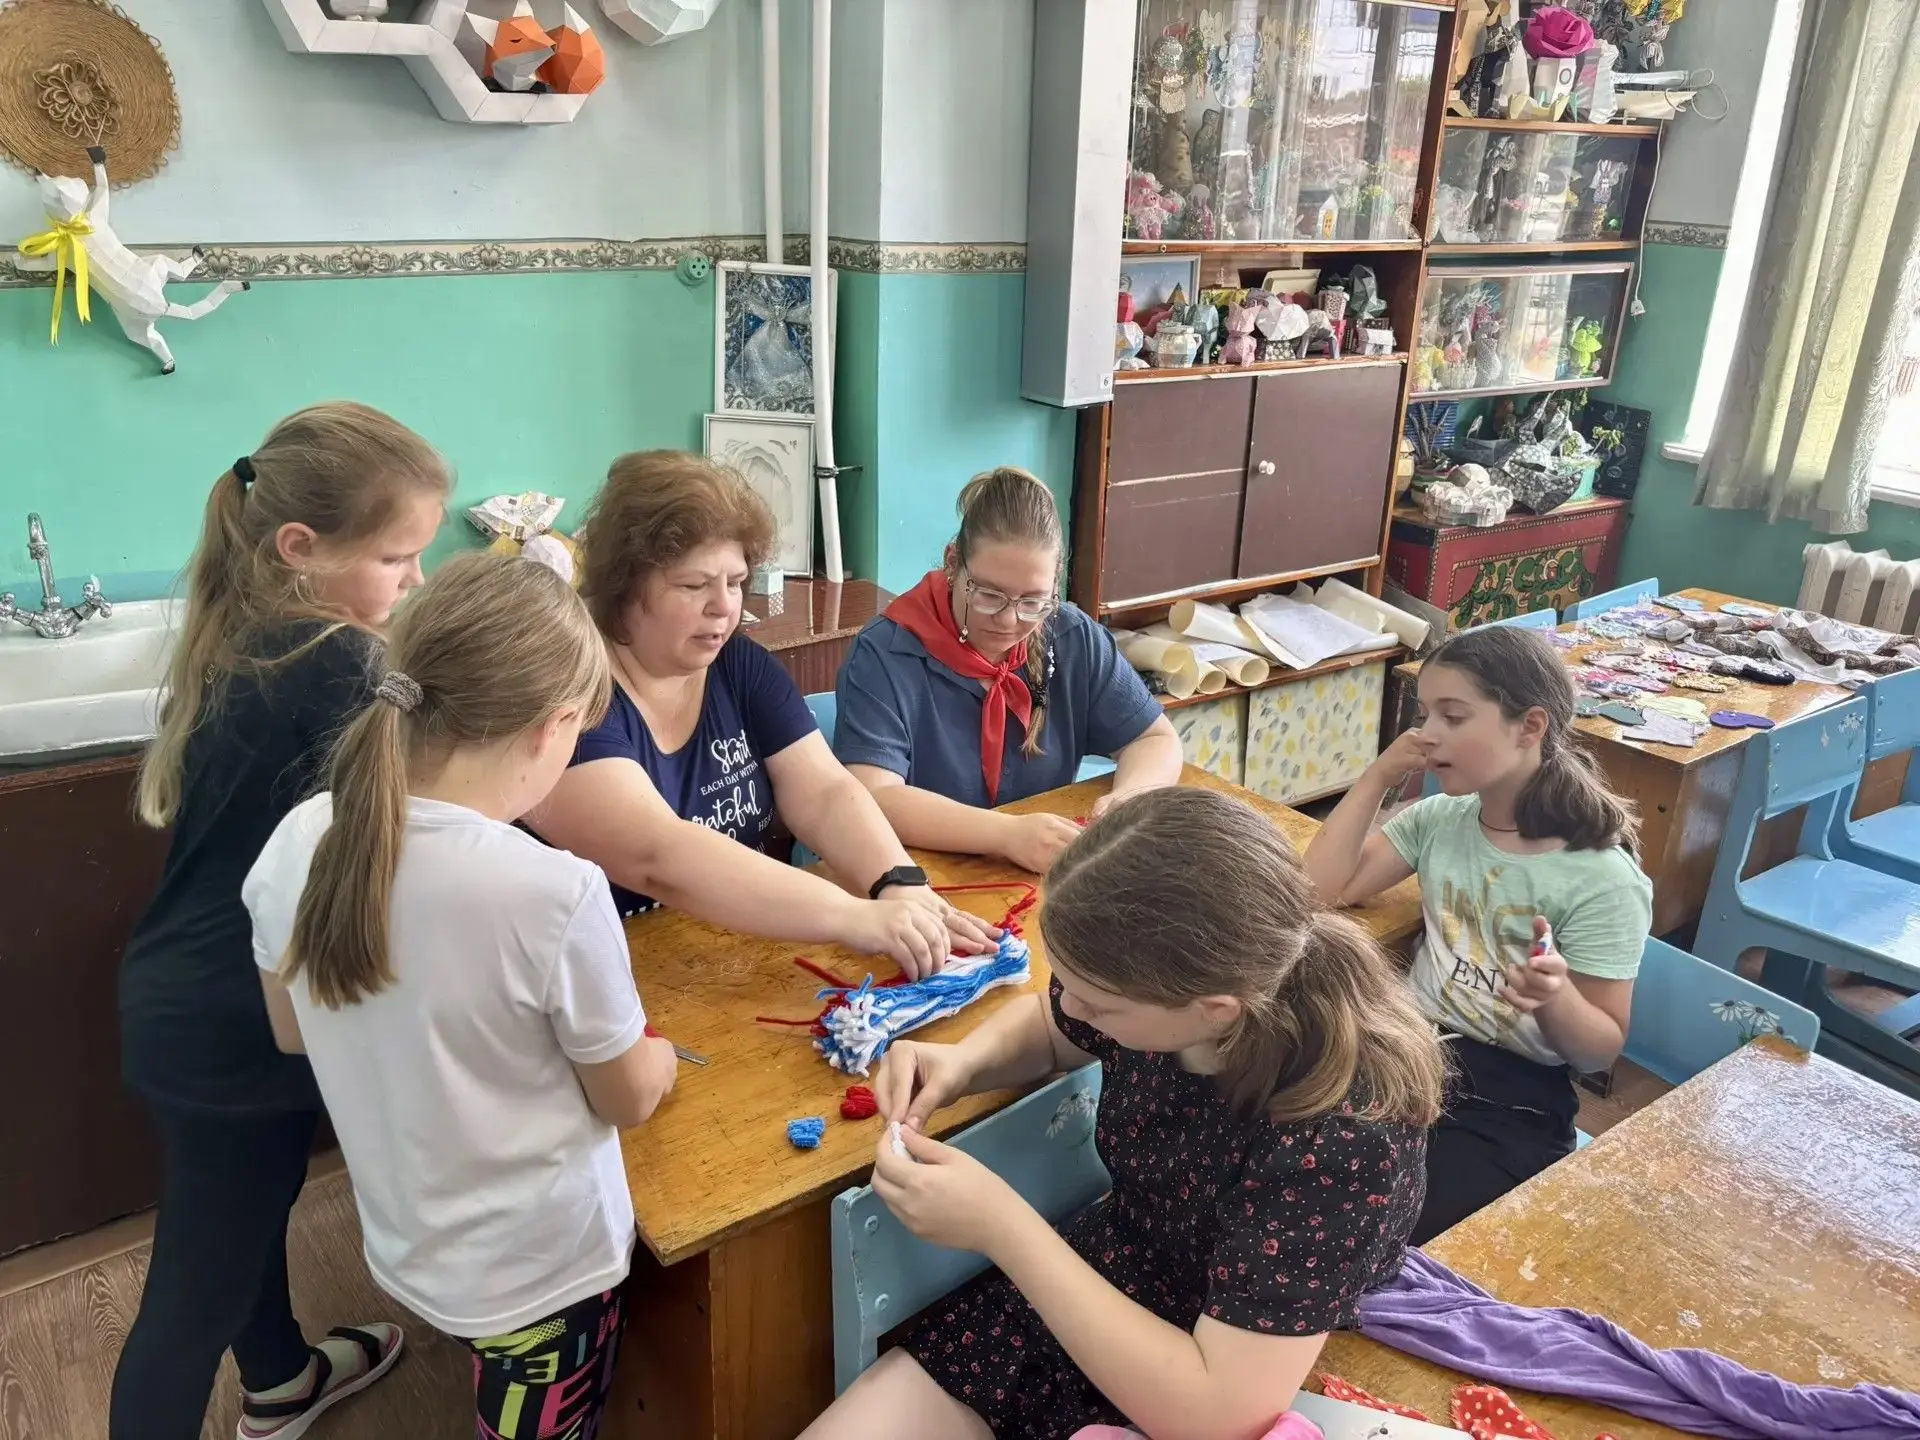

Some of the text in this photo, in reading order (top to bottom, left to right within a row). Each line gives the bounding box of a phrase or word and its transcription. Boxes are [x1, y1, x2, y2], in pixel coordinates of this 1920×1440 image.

[711, 729, 752, 774] Start
[691, 780, 761, 829] rateful
[700, 779, 725, 796] EACH
[725, 771, 740, 785] DAY
